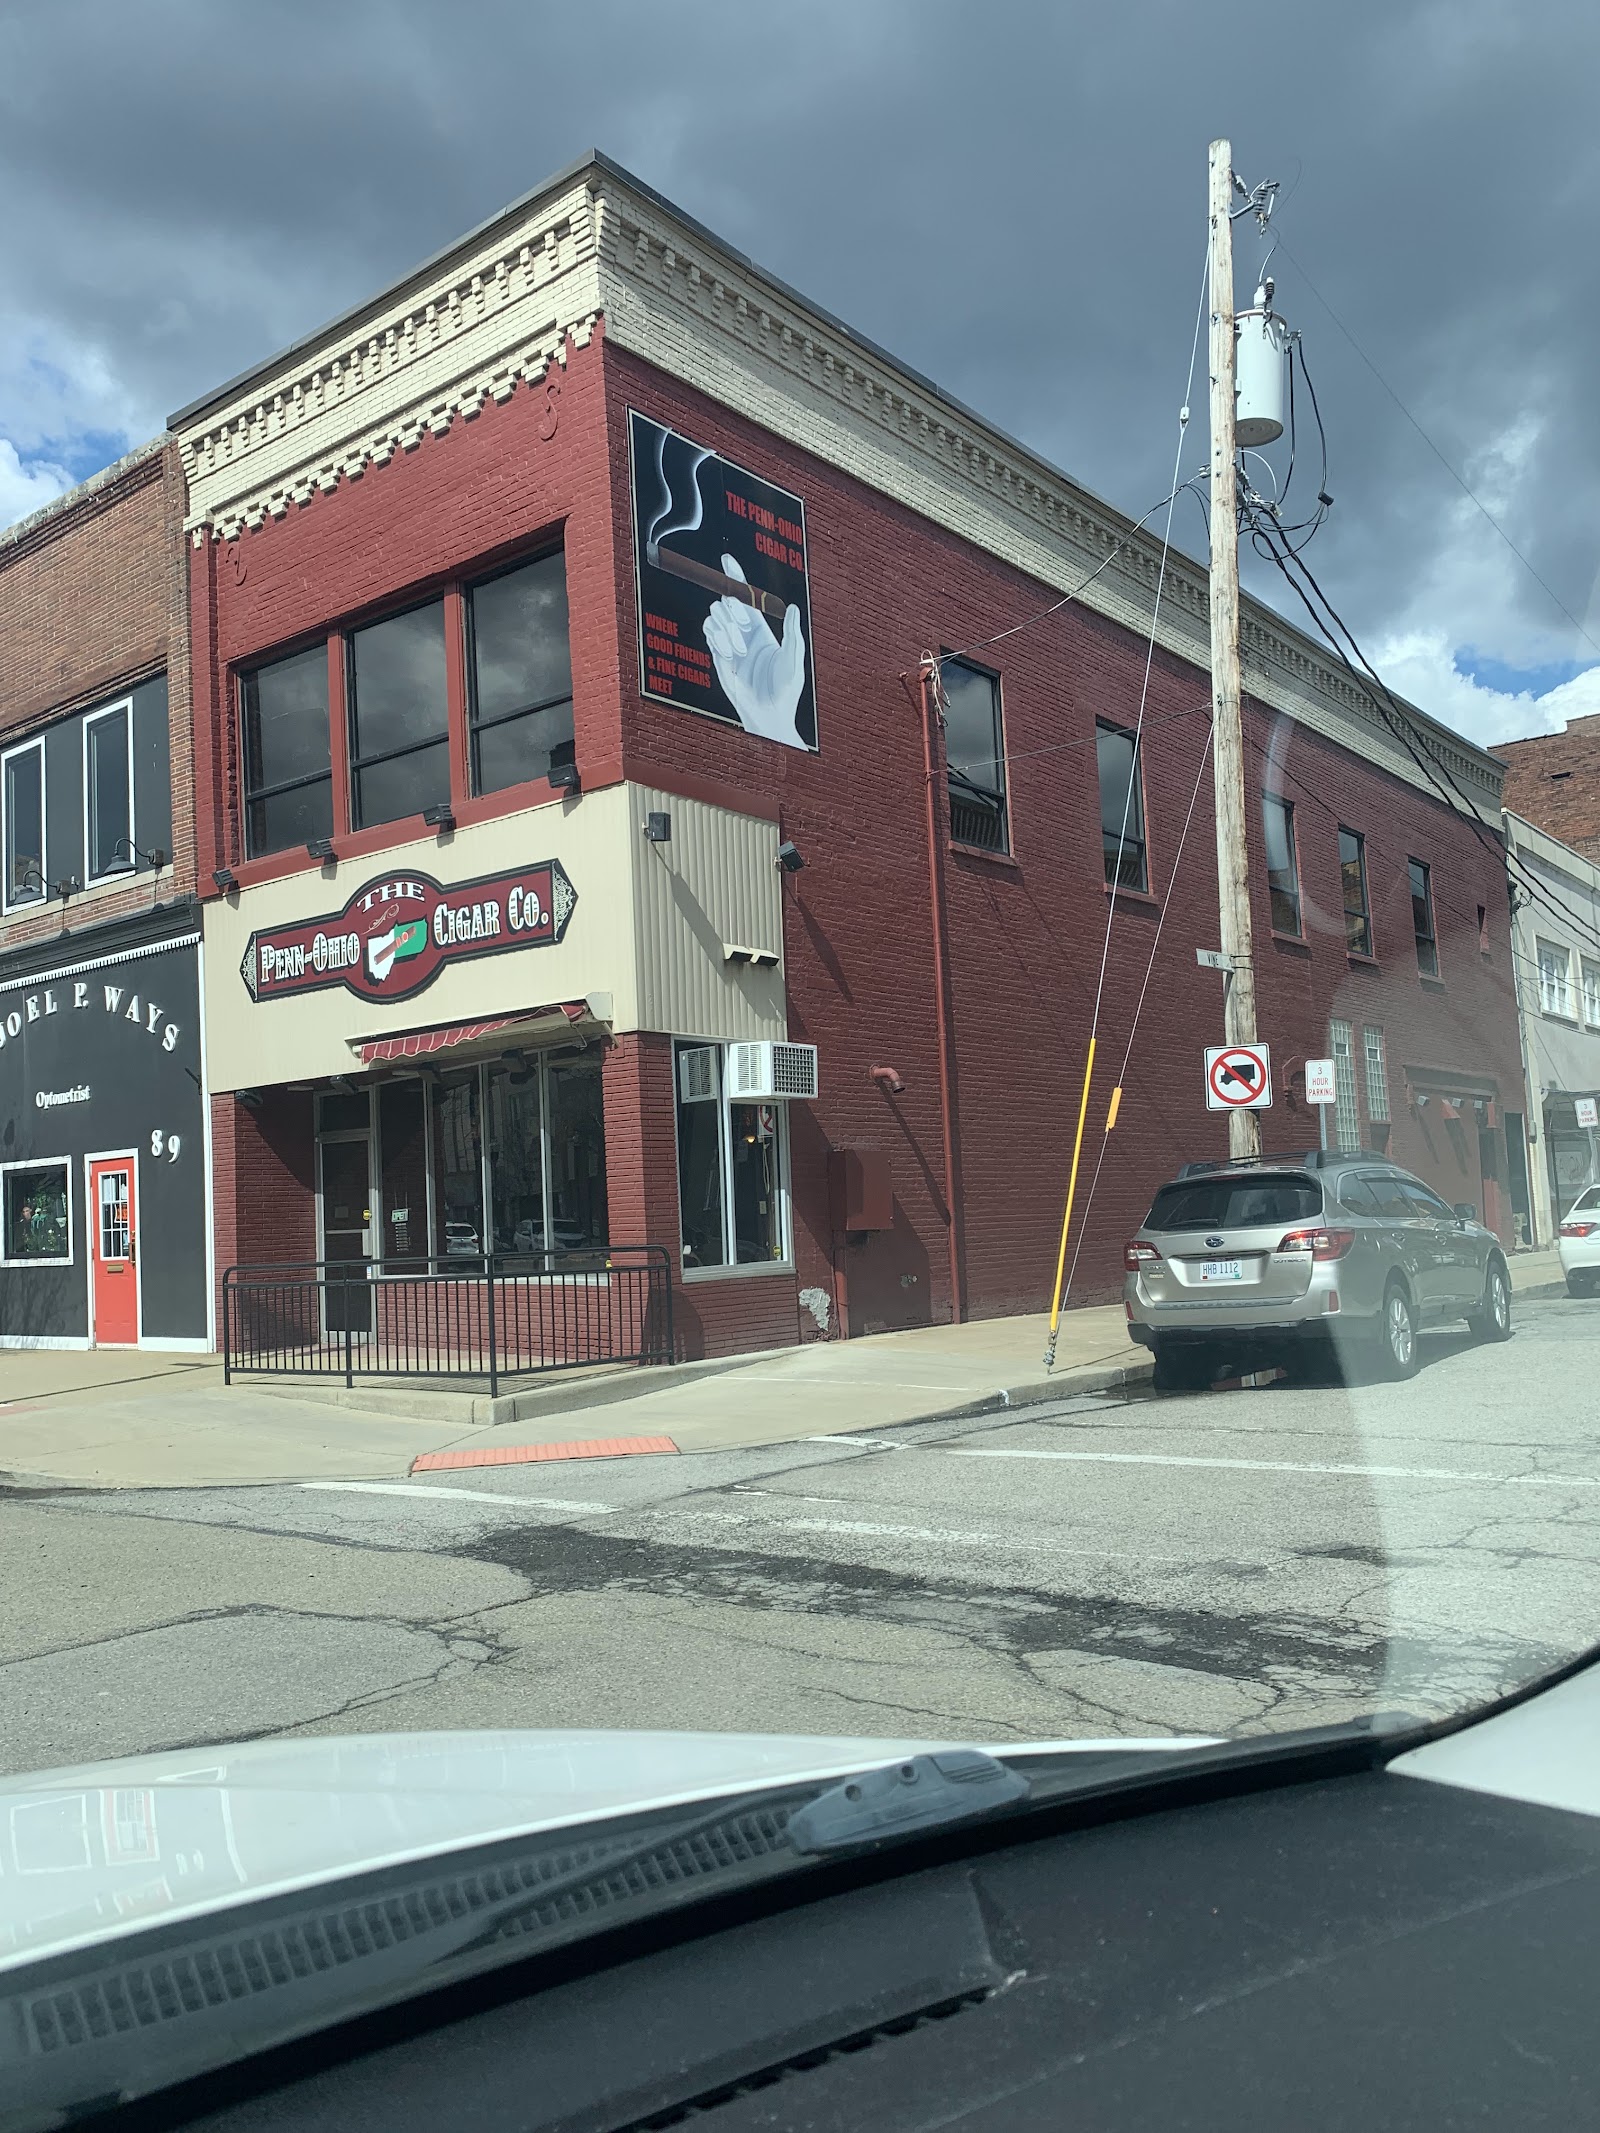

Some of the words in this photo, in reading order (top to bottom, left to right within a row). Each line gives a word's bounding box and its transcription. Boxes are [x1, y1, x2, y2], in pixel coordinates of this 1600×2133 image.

[725, 490, 747, 518] THE
[748, 502, 803, 545] PENN-OHIO
[755, 531, 787, 564] CIGAR
[645, 612, 678, 637] WHERE
[646, 632, 673, 655] GOOD
[674, 642, 711, 669] FRIENDS
[647, 656, 655, 670] &
[656, 656, 677, 676] FINE
[677, 663, 711, 689] CIGARS
[648, 674, 672, 695] MEET
[356, 881, 425, 913] THE
[73, 982, 89, 1009] P.
[104, 985, 180, 1052] WAYS
[1312, 1077, 1329, 1086] HOUR
[1317, 1066, 1323, 1075] 3
[36, 1085, 91, 1109] Optometrist
[1308, 1087, 1333, 1097] PARKING
[151, 1129, 181, 1163] 89
[1202, 1263, 1217, 1275] HHB
[1220, 1262, 1239, 1273] 1112
